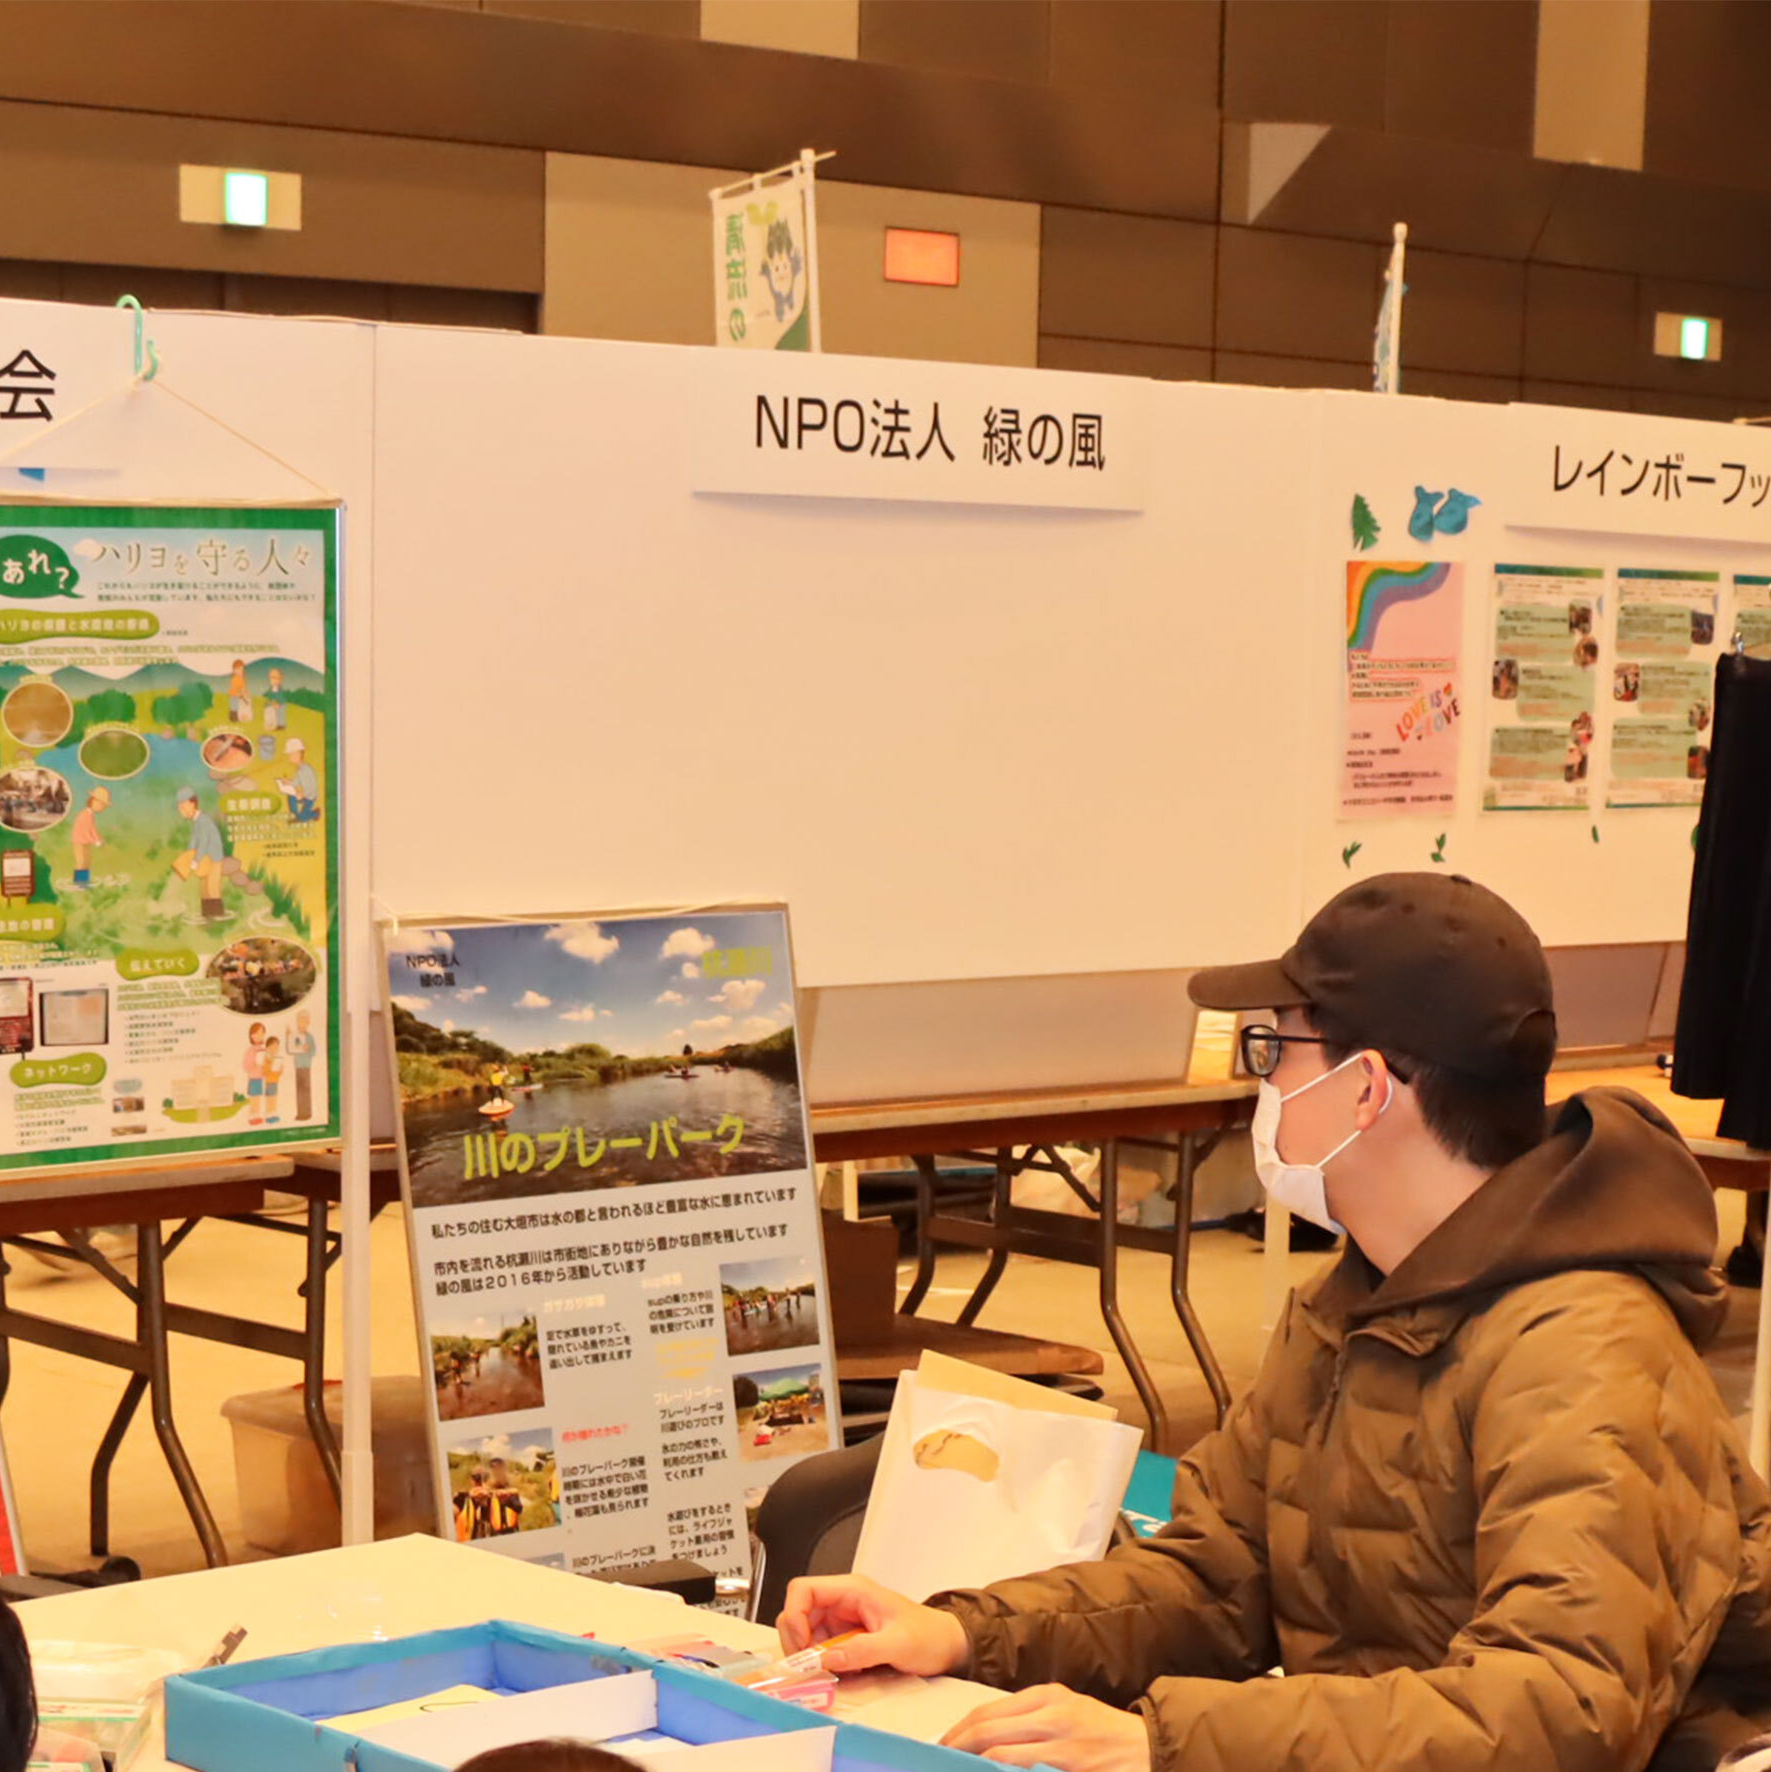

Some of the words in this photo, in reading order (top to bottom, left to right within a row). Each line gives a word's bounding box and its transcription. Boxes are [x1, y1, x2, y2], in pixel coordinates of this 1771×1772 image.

[755, 394, 956, 462] NPO法人
[982, 405, 1106, 471] 緑の風
[92, 538, 310, 576] ハリヨを守る人々
[464, 1113, 745, 1180] 川のプレーパーク
